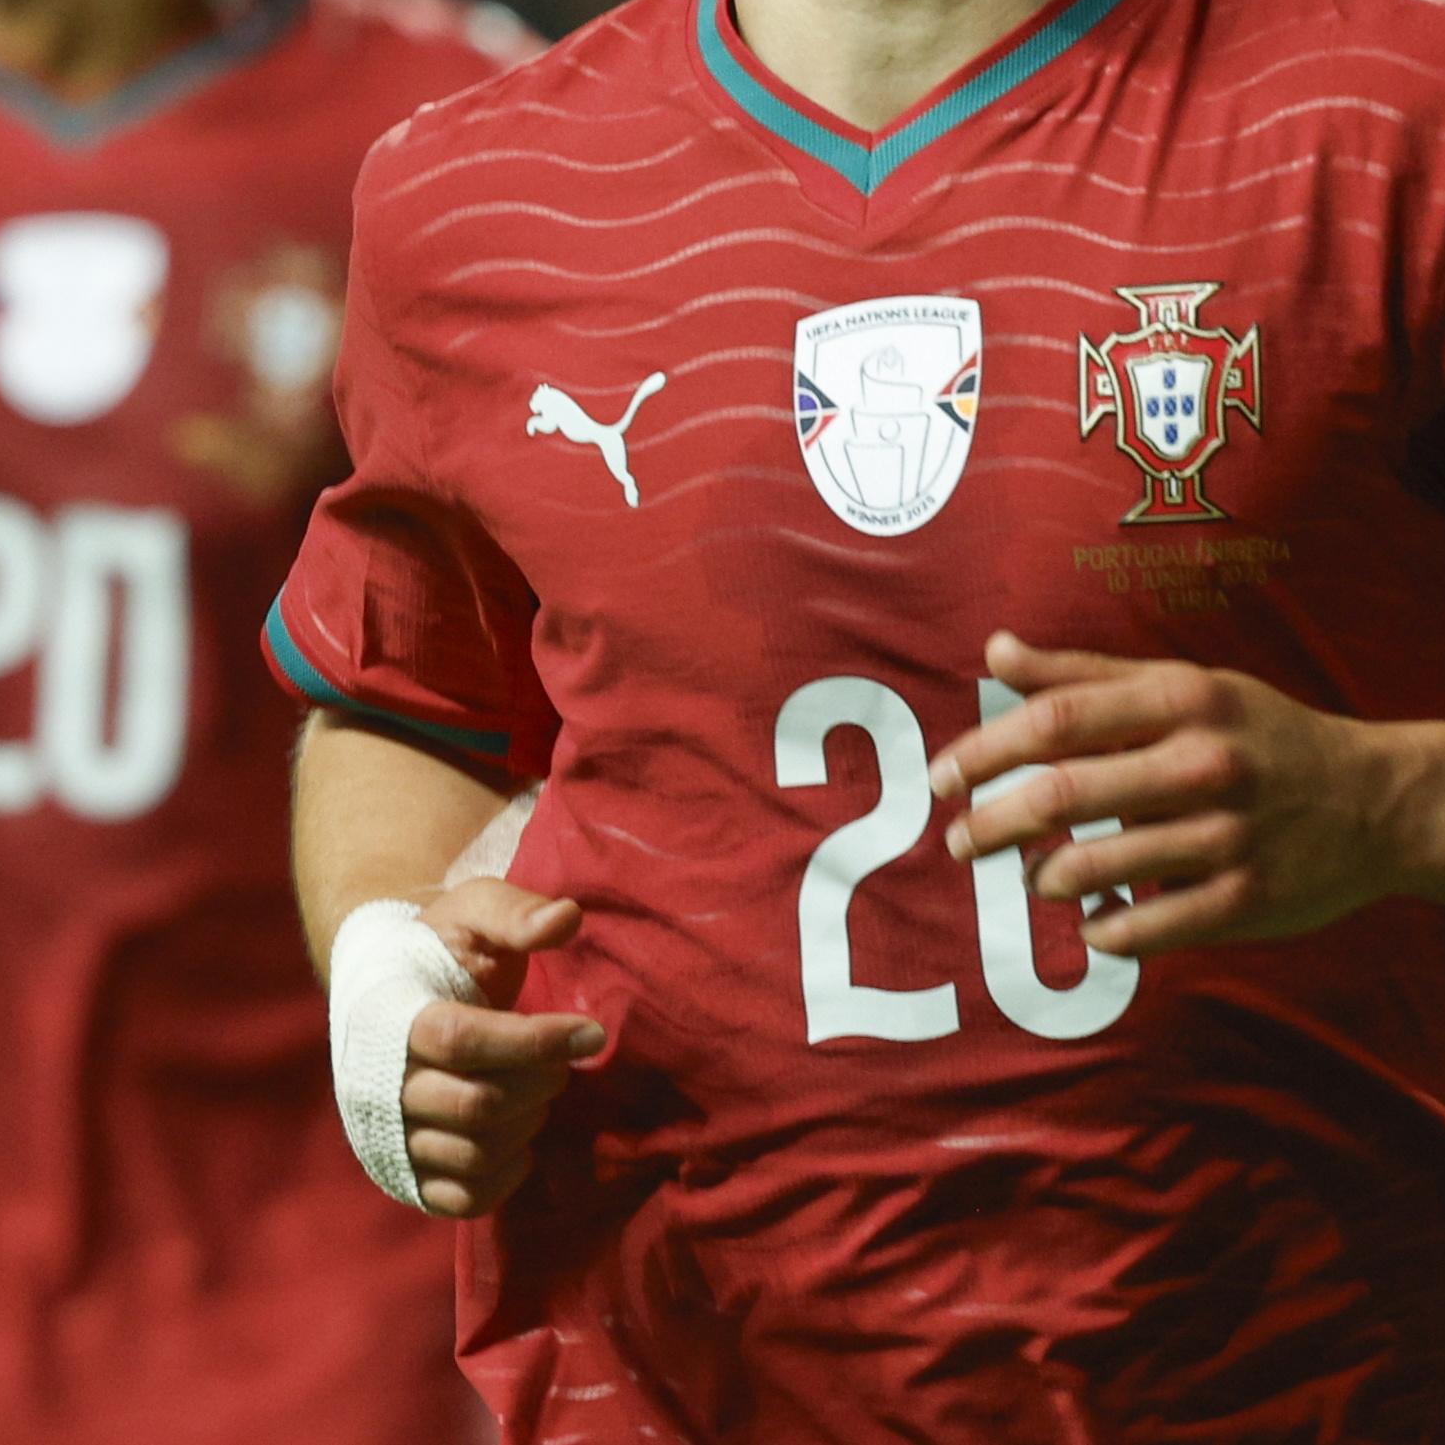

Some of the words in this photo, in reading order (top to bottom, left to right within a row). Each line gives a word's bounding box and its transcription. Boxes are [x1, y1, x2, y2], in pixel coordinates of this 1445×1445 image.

[806, 319, 842, 340] UEFA
[846, 307, 909, 327] NATIONS
[914, 307, 971, 323] LEAGUE
[847, 504, 900, 526] WINNER
